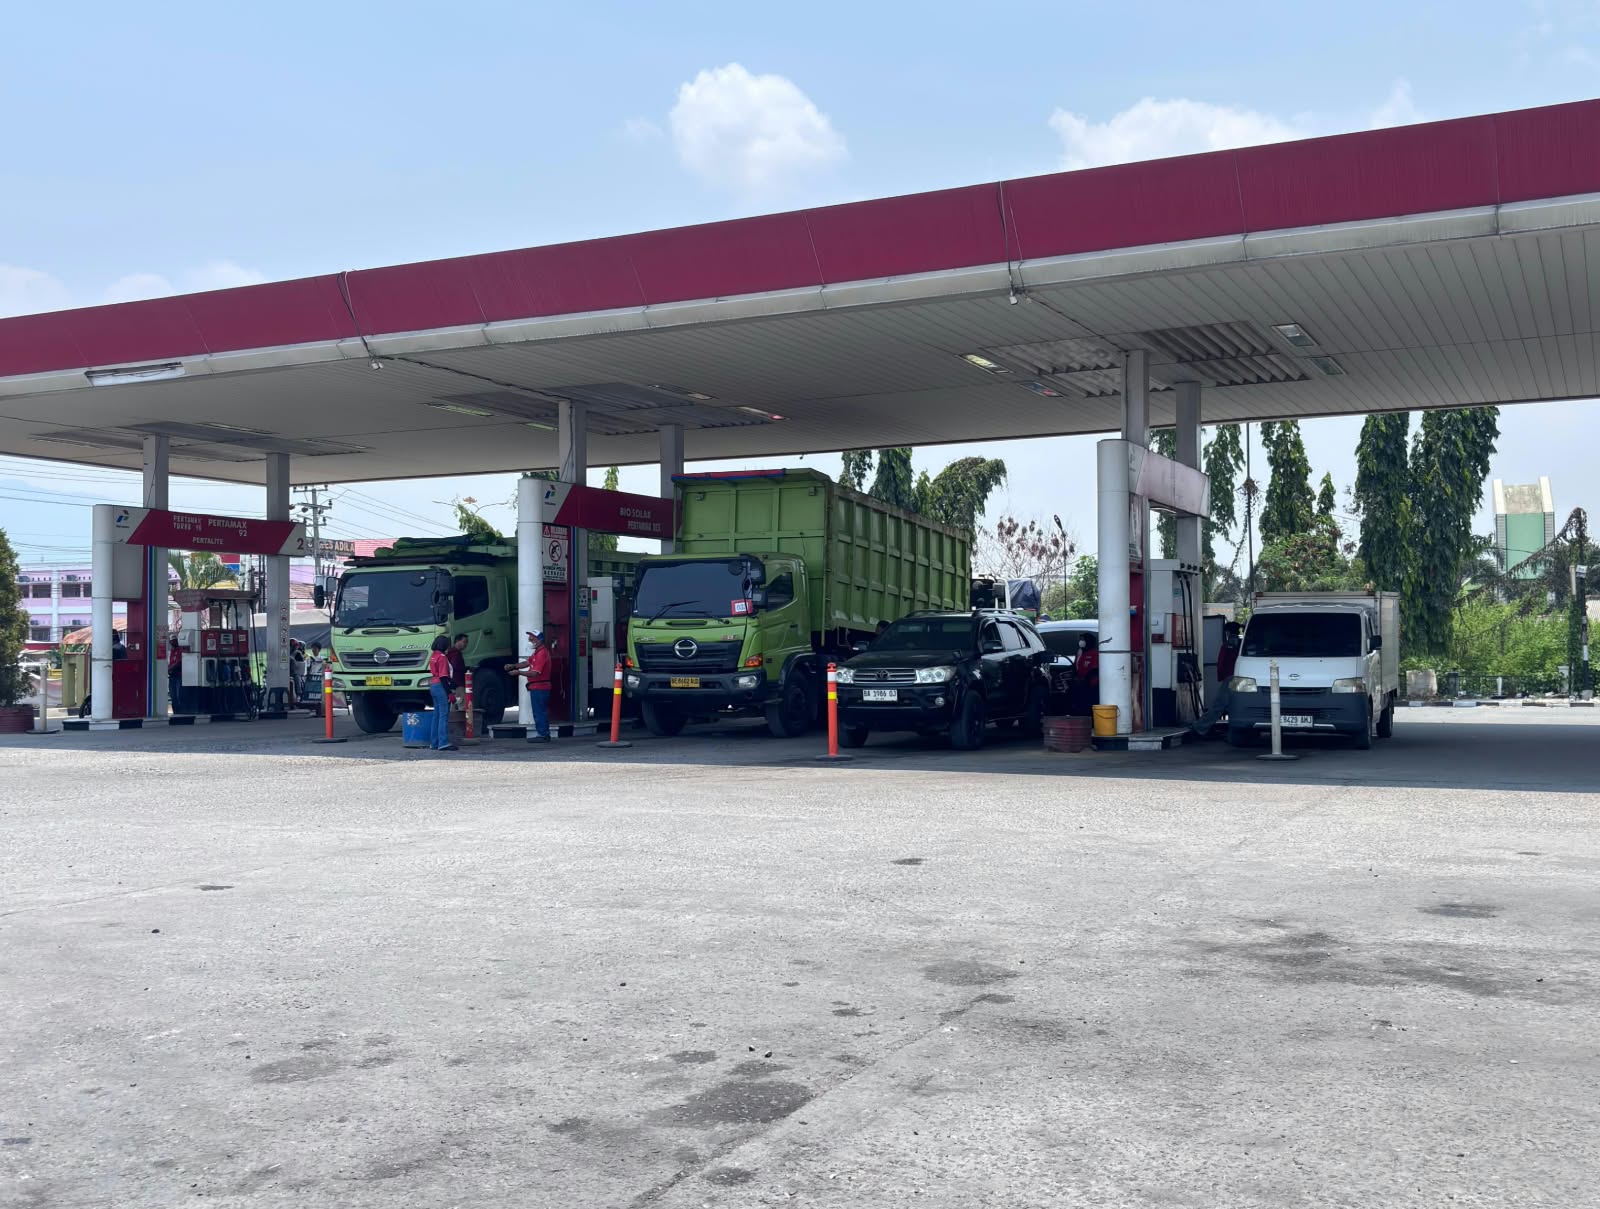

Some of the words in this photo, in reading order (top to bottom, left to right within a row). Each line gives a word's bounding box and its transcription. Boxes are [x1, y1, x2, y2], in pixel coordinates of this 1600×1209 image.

[208, 518, 247, 529] PERTAMAX
[238, 529, 247, 537] 92
[192, 537, 224, 545] PERTALITE
[296, 538, 304, 550] 2
